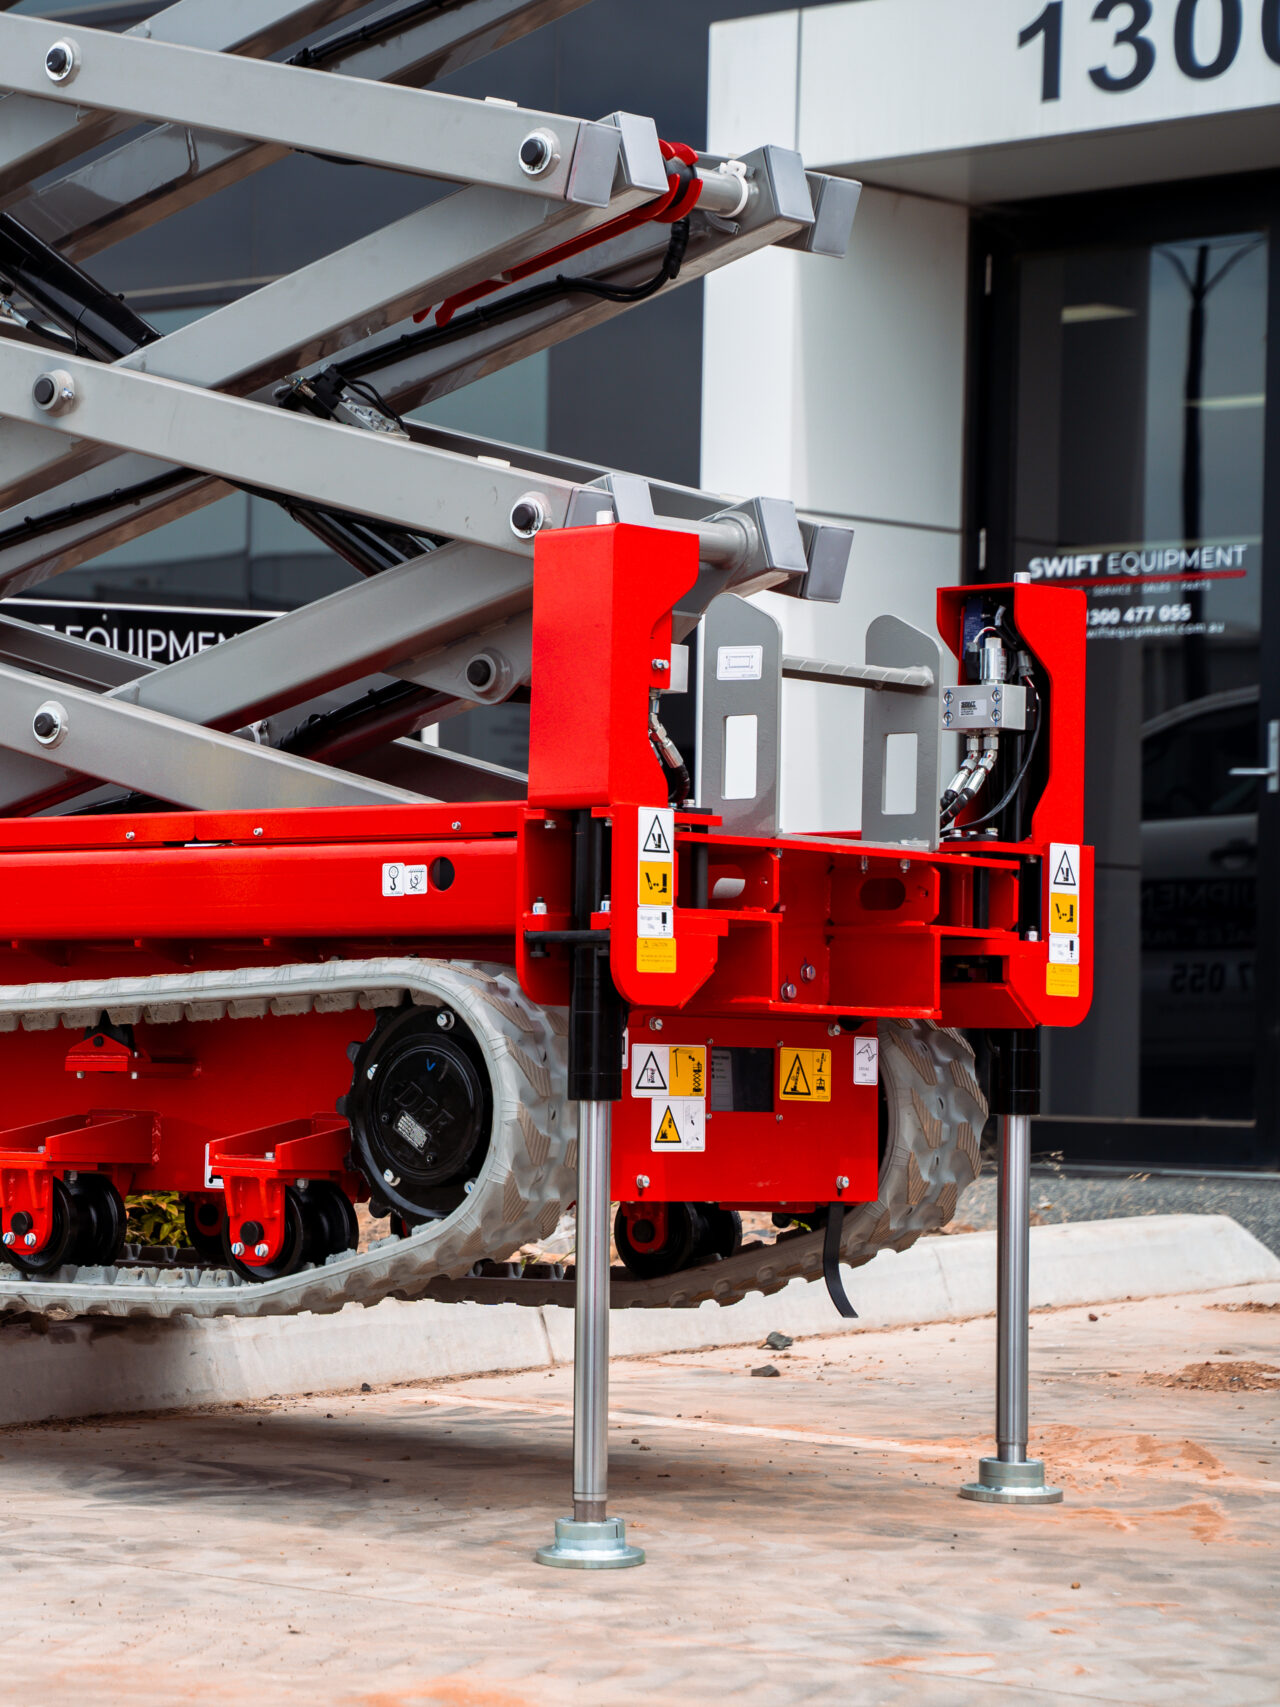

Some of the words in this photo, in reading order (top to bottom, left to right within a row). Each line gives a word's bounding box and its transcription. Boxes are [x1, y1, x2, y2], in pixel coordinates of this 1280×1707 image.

[1017, 0, 1280, 104] 130
[1028, 554, 1103, 579] SWIFT
[1107, 544, 1248, 576] EQUIPMENT
[1123, 605, 1156, 623] 477
[1158, 604, 1192, 622] 055
